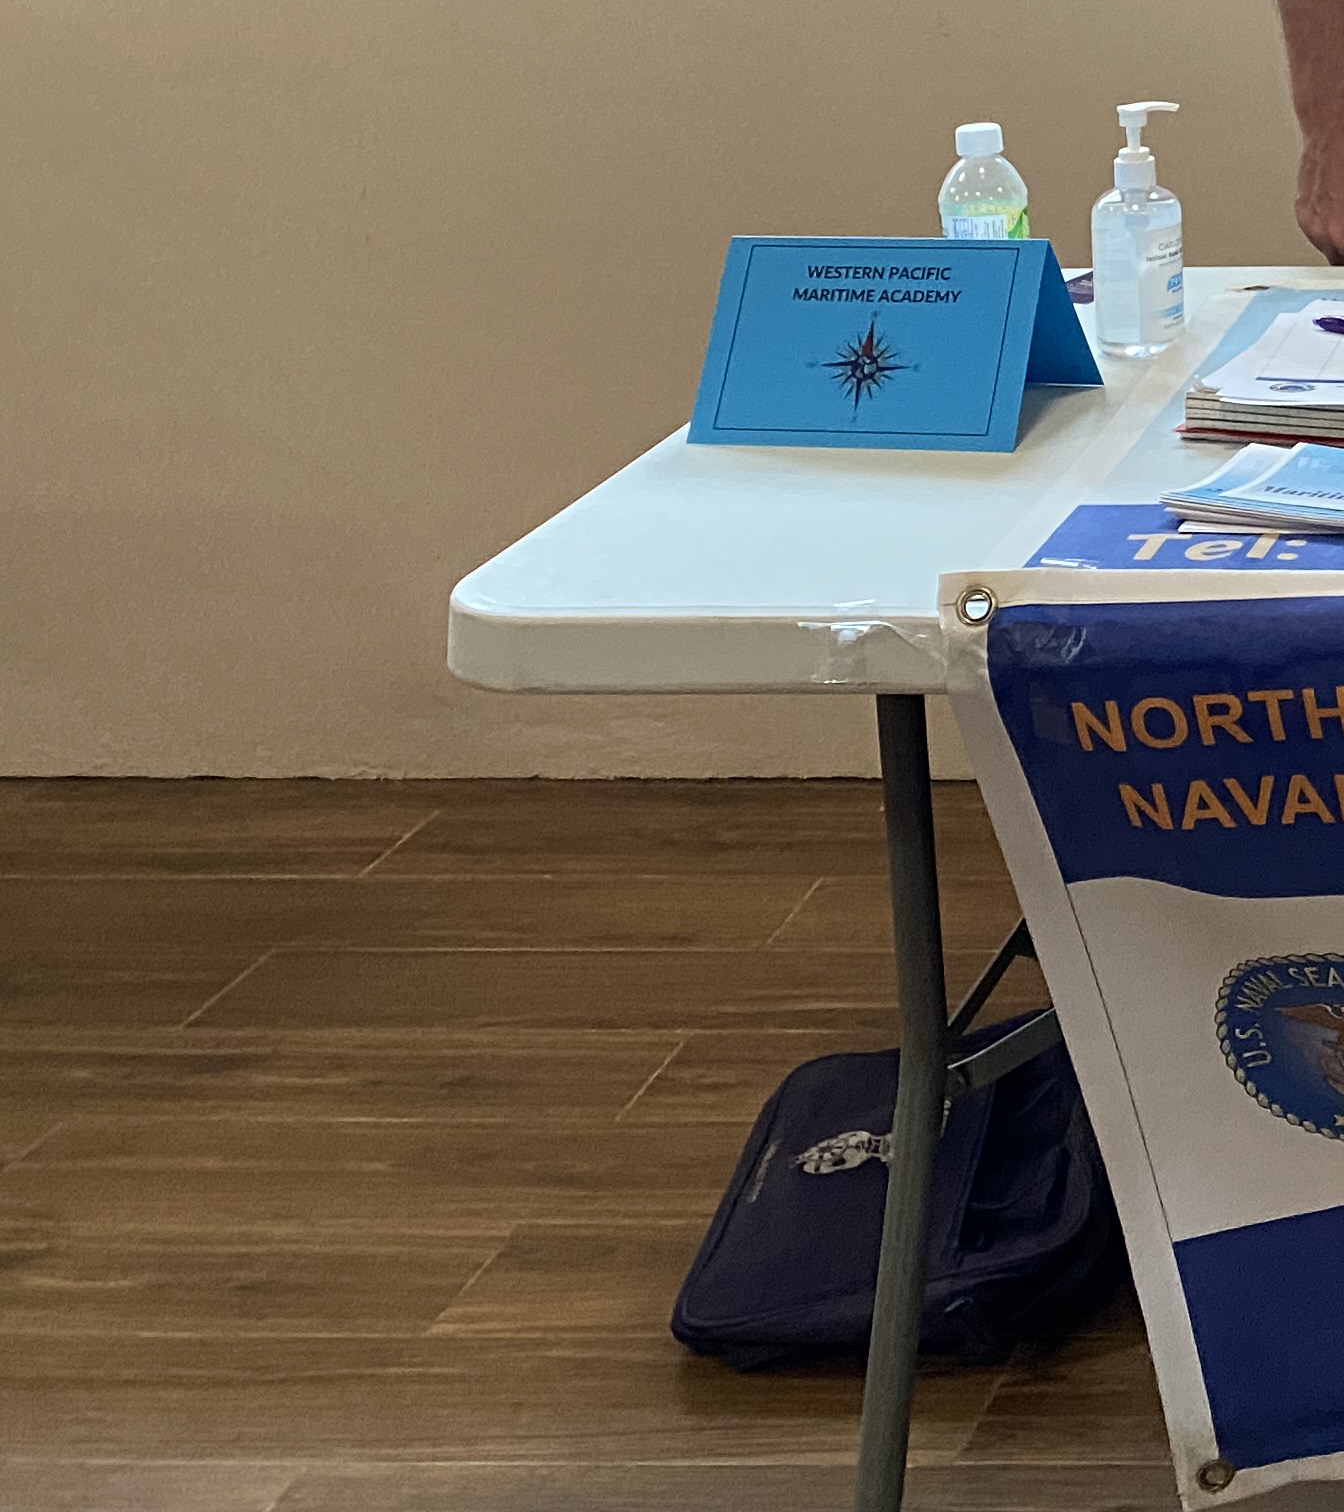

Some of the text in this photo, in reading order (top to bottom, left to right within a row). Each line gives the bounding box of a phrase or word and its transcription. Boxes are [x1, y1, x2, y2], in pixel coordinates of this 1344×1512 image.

[807, 265, 952, 281] WESTERN PACIFIC
[793, 288, 962, 303] MARITIME ACADEMY
[1126, 533, 1307, 563] Tel:
[1234, 969, 1291, 1012] NAVAL
[1234, 1022, 1272, 1068] U.S.
